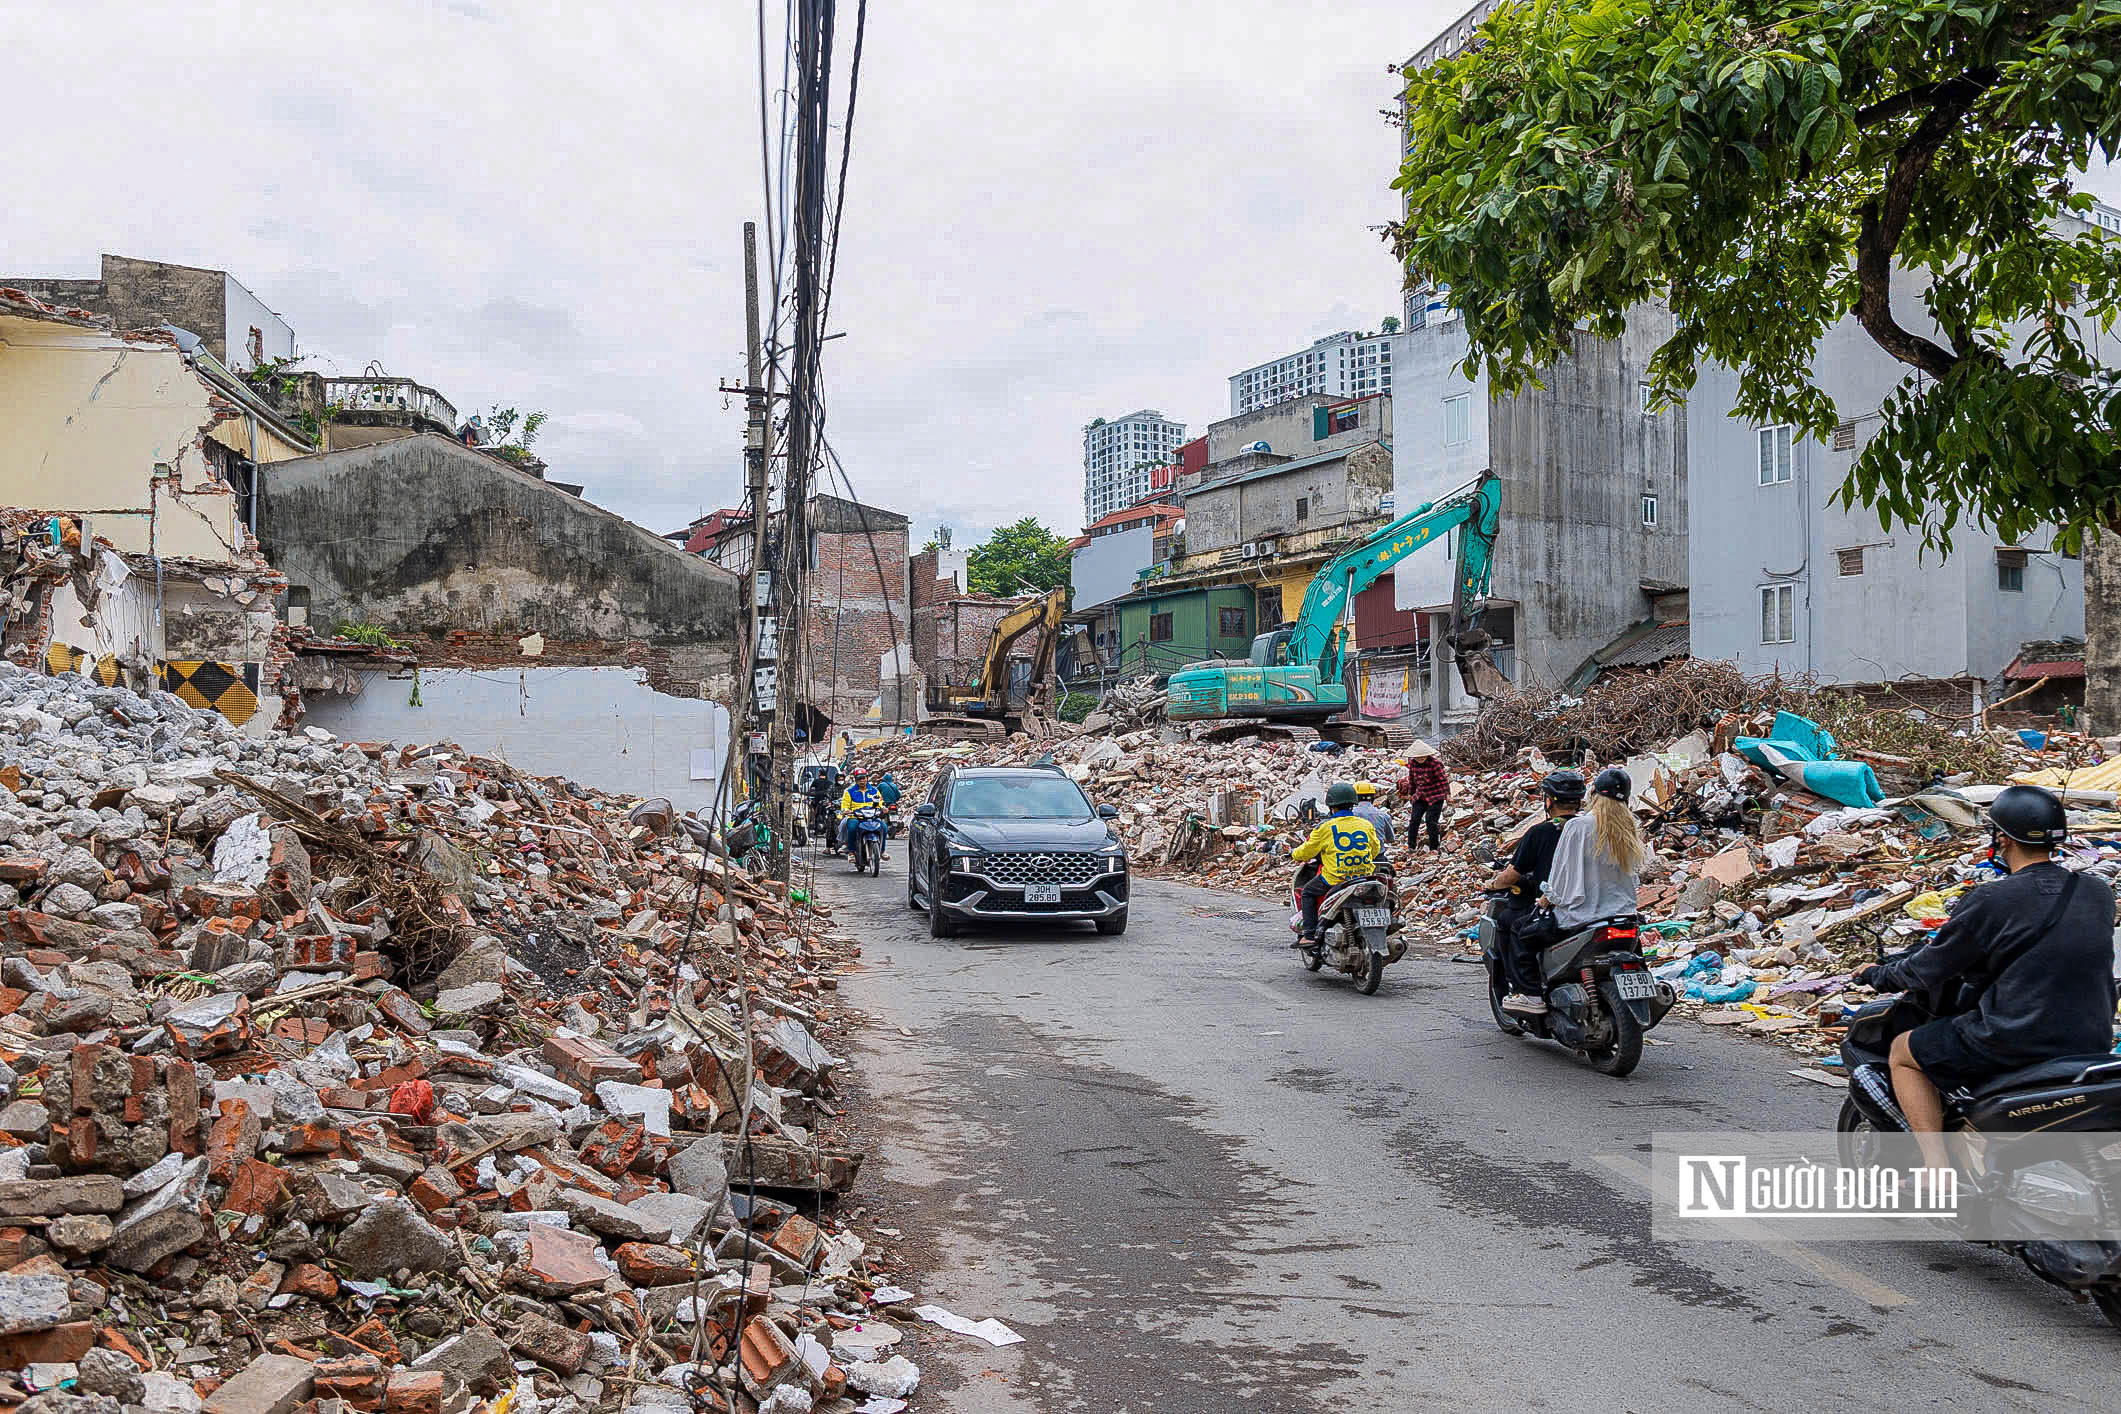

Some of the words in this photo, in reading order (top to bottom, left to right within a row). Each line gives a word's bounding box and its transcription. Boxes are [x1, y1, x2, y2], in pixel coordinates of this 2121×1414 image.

[1331, 825, 1369, 852] be
[1336, 851, 1371, 867] Food
[1029, 893, 1057, 902] 285.80
[1622, 985, 1656, 998] 137.21
